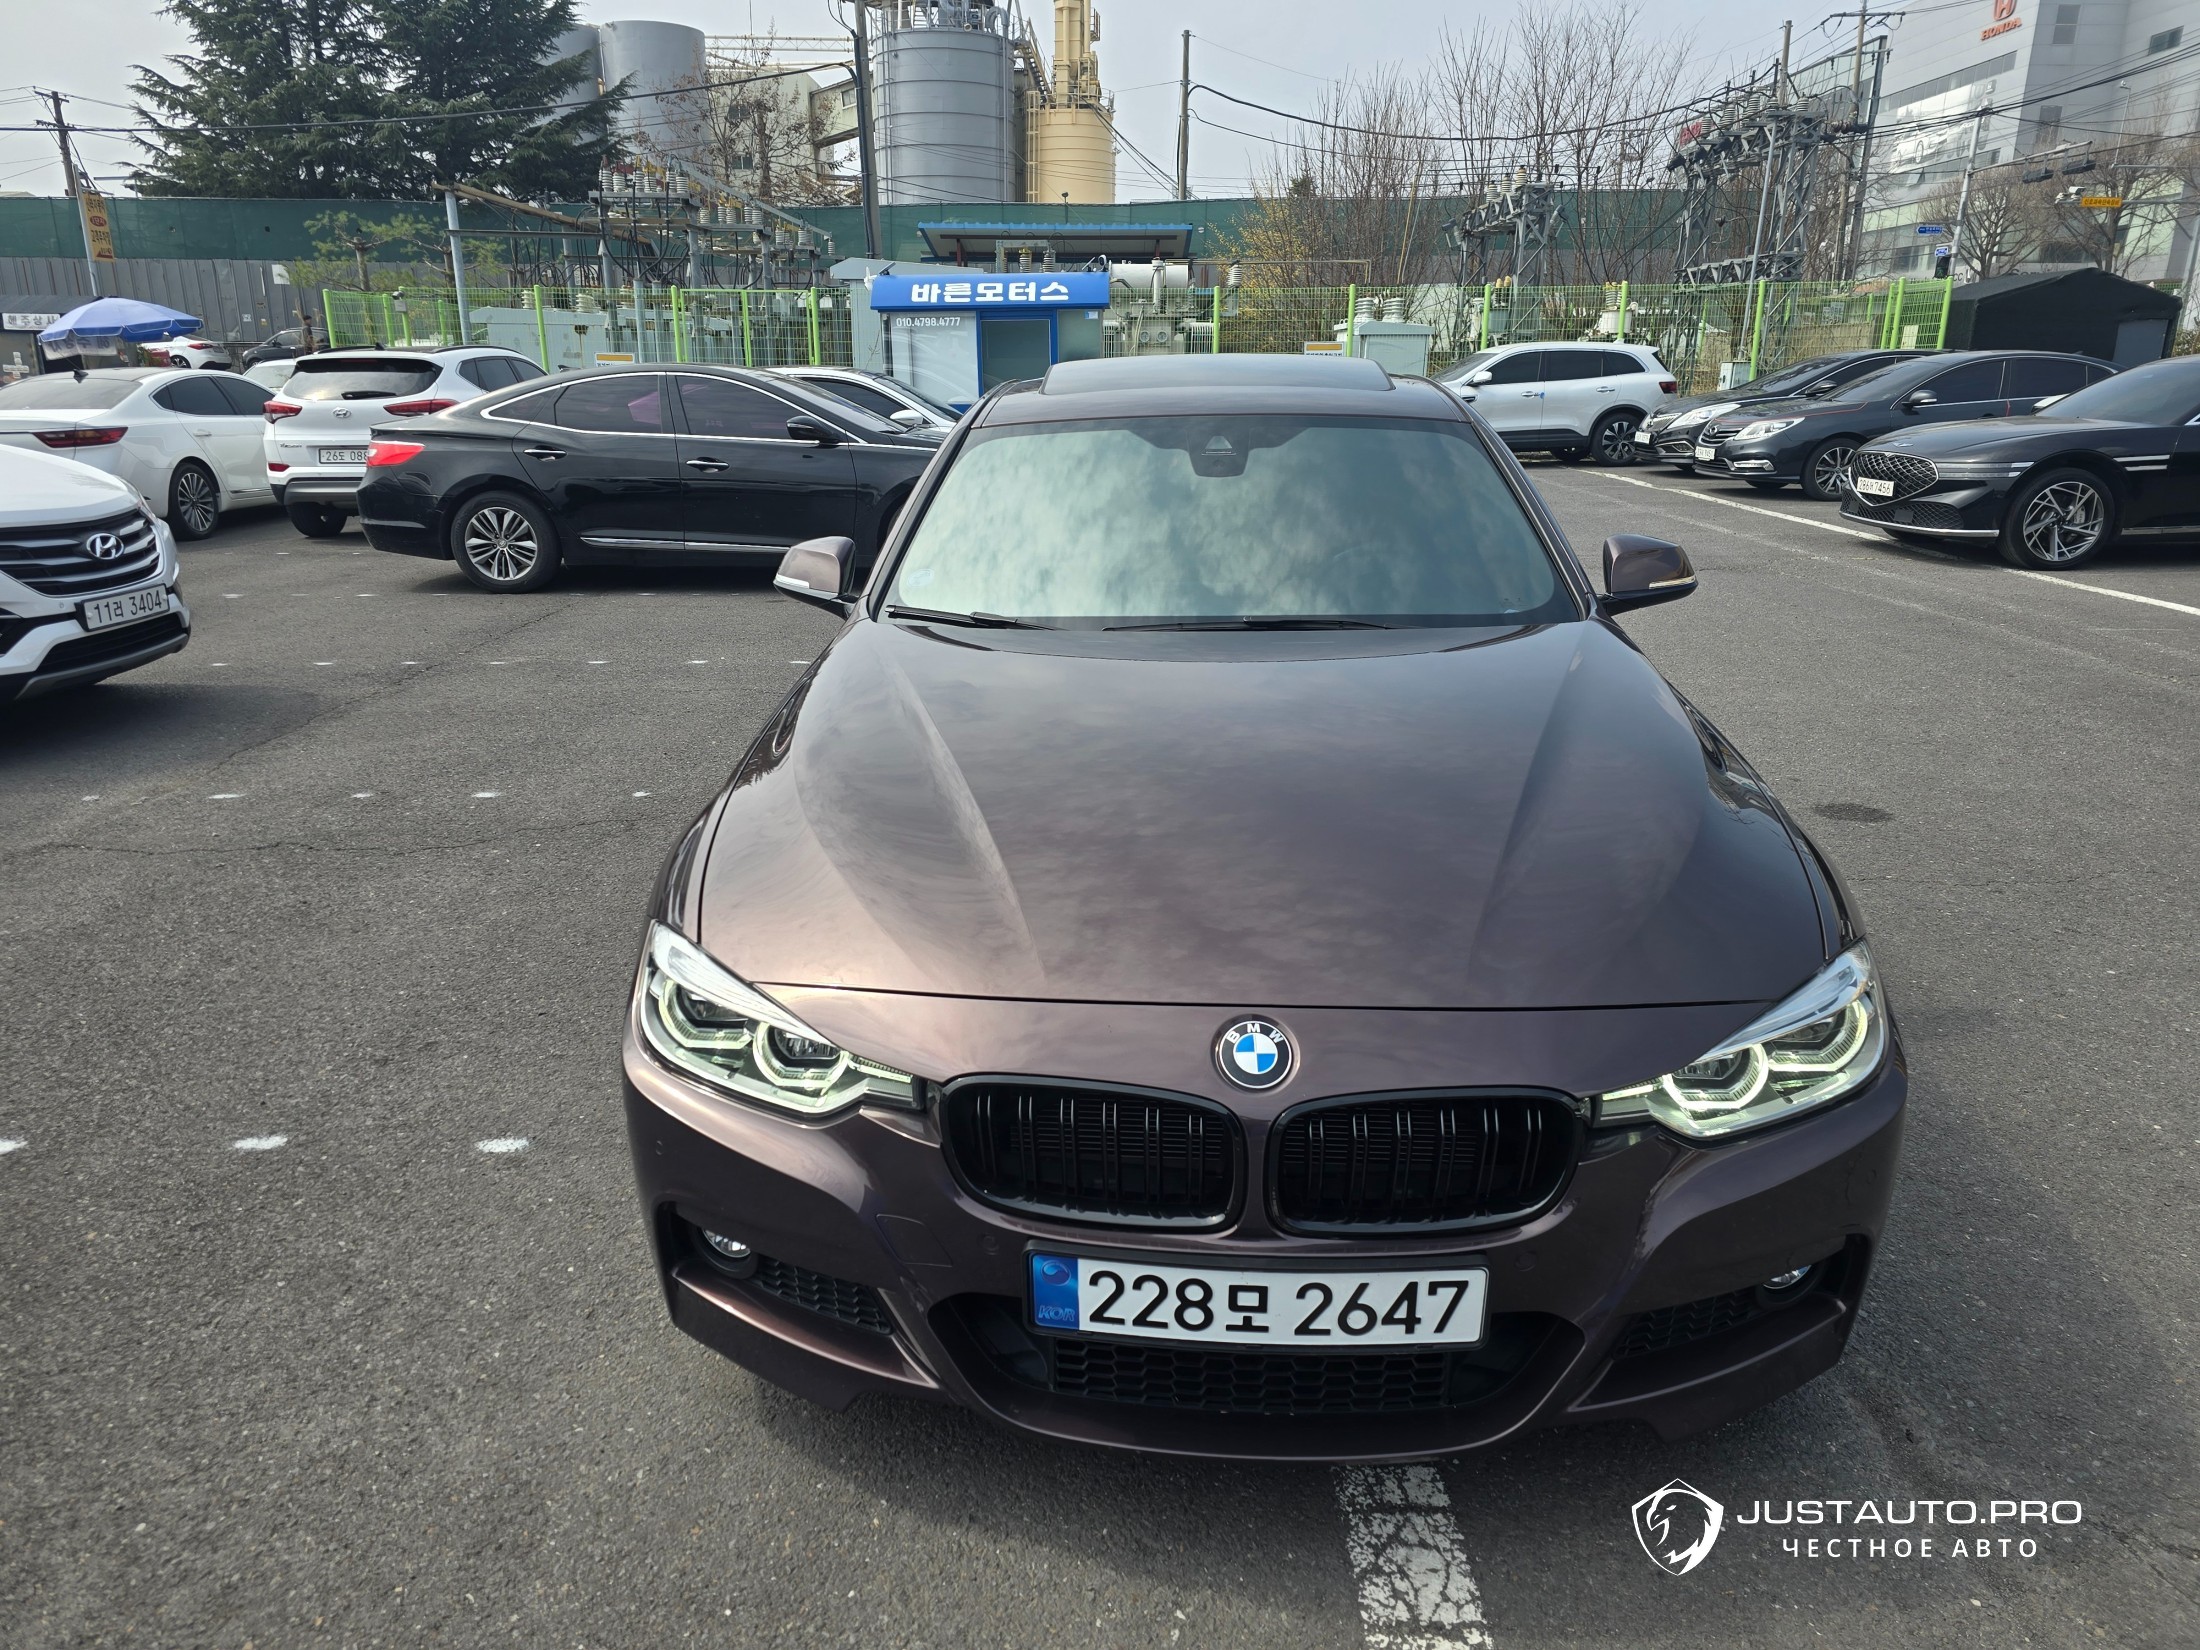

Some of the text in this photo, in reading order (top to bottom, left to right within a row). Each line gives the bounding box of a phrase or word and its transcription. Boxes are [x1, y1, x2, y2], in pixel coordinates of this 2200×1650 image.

[1980, 17, 2022, 41] HONDA
[911, 281, 1069, 303] 바른모터스
[895, 316, 961, 327] 010.4798.4777
[350, 451, 368, 461] 088
[129, 589, 162, 615] 3404
[1226, 1023, 1284, 1043] BMW
[1038, 1305, 1076, 1321] KOR
[1088, 1269, 1469, 1336] 228모 2647
